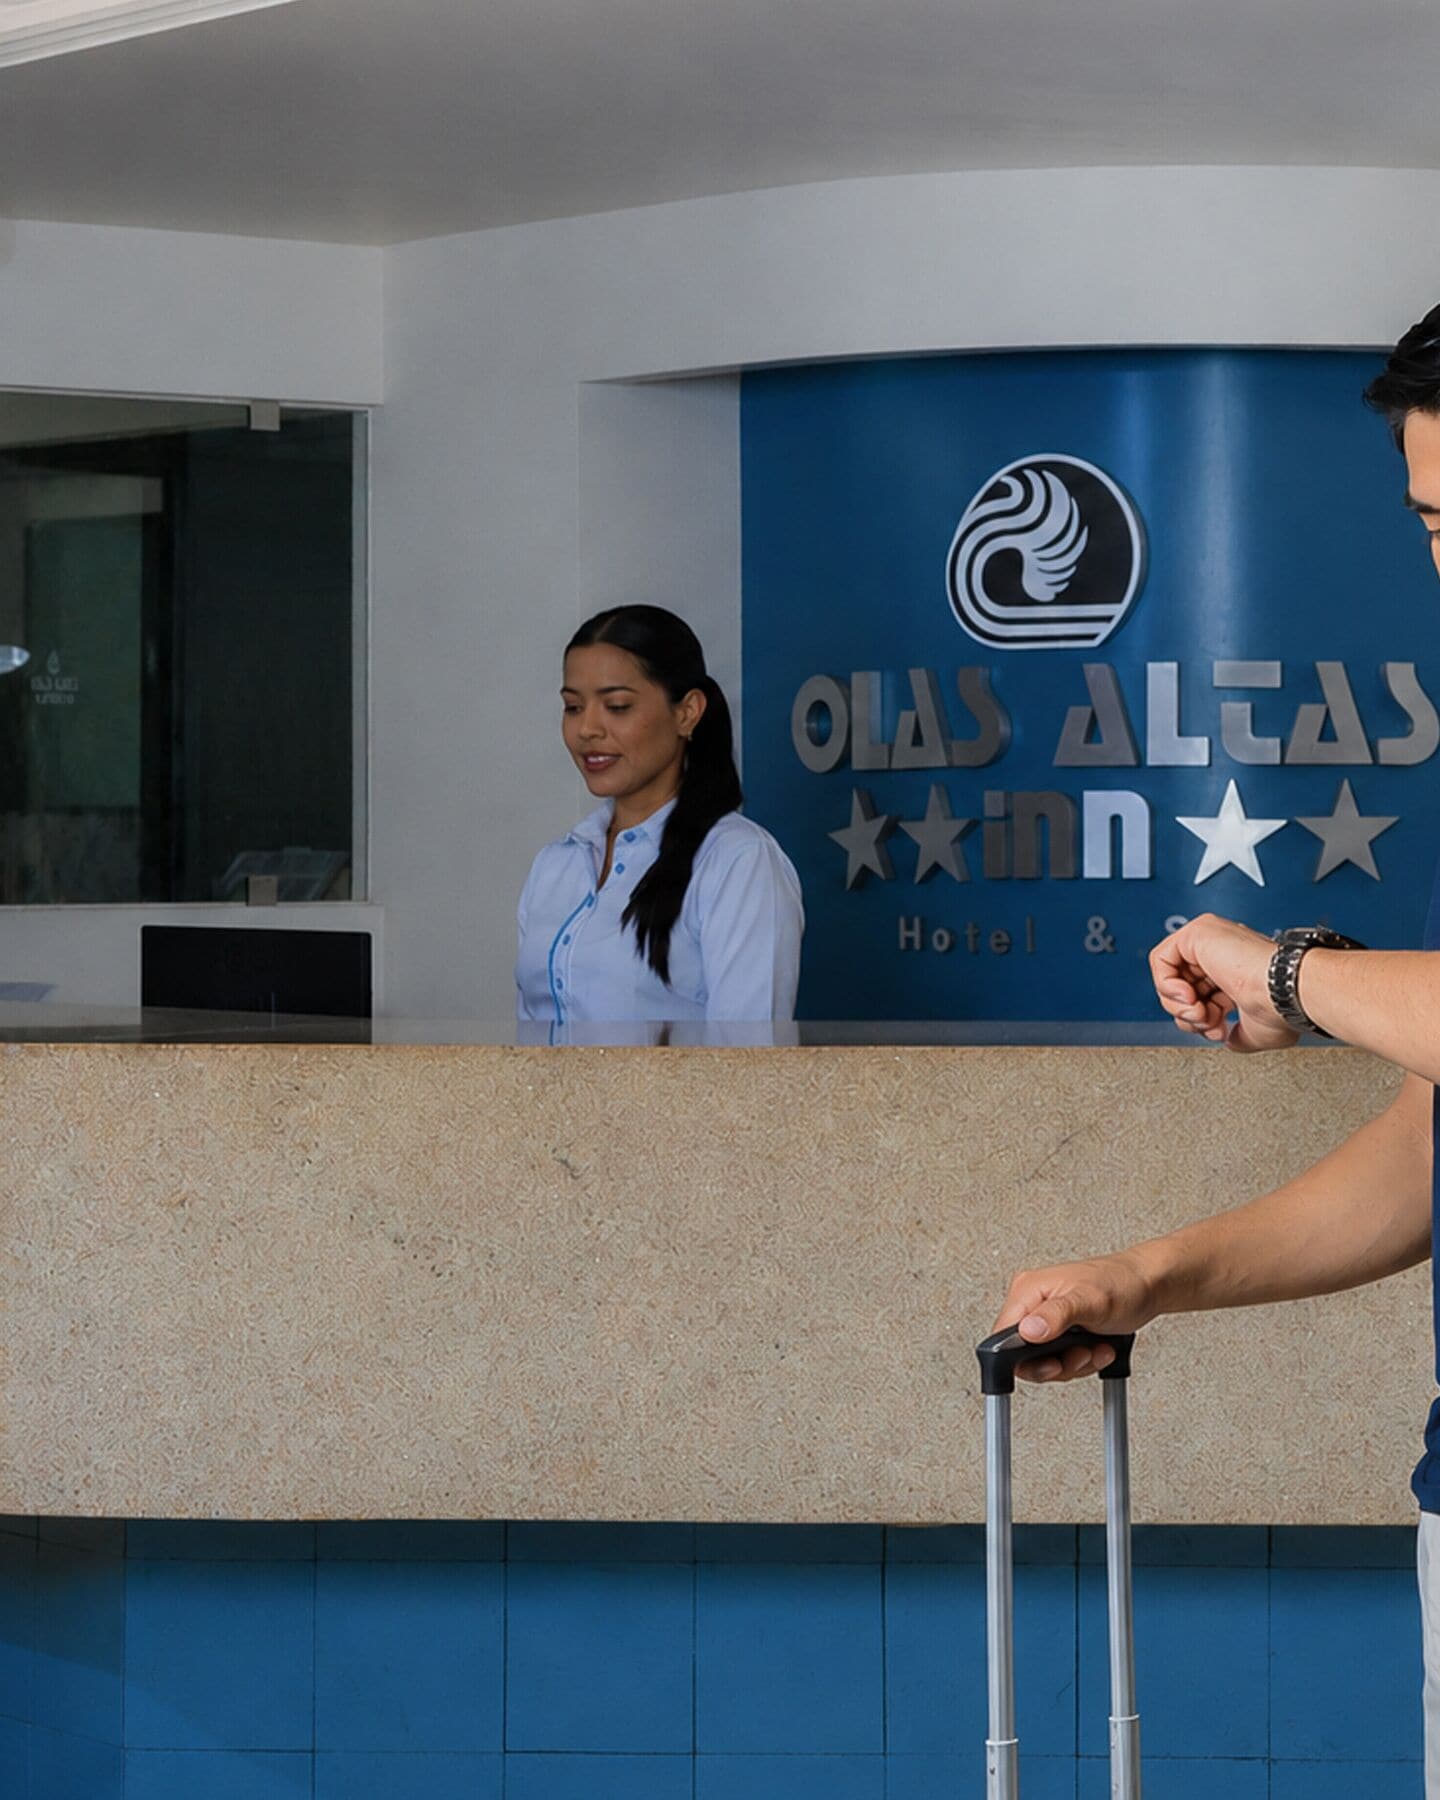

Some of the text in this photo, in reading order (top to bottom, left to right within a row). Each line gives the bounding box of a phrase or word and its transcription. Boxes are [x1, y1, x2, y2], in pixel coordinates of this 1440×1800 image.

[791, 661, 1012, 774] OLAS
[898, 915, 1115, 954] Hotel &
